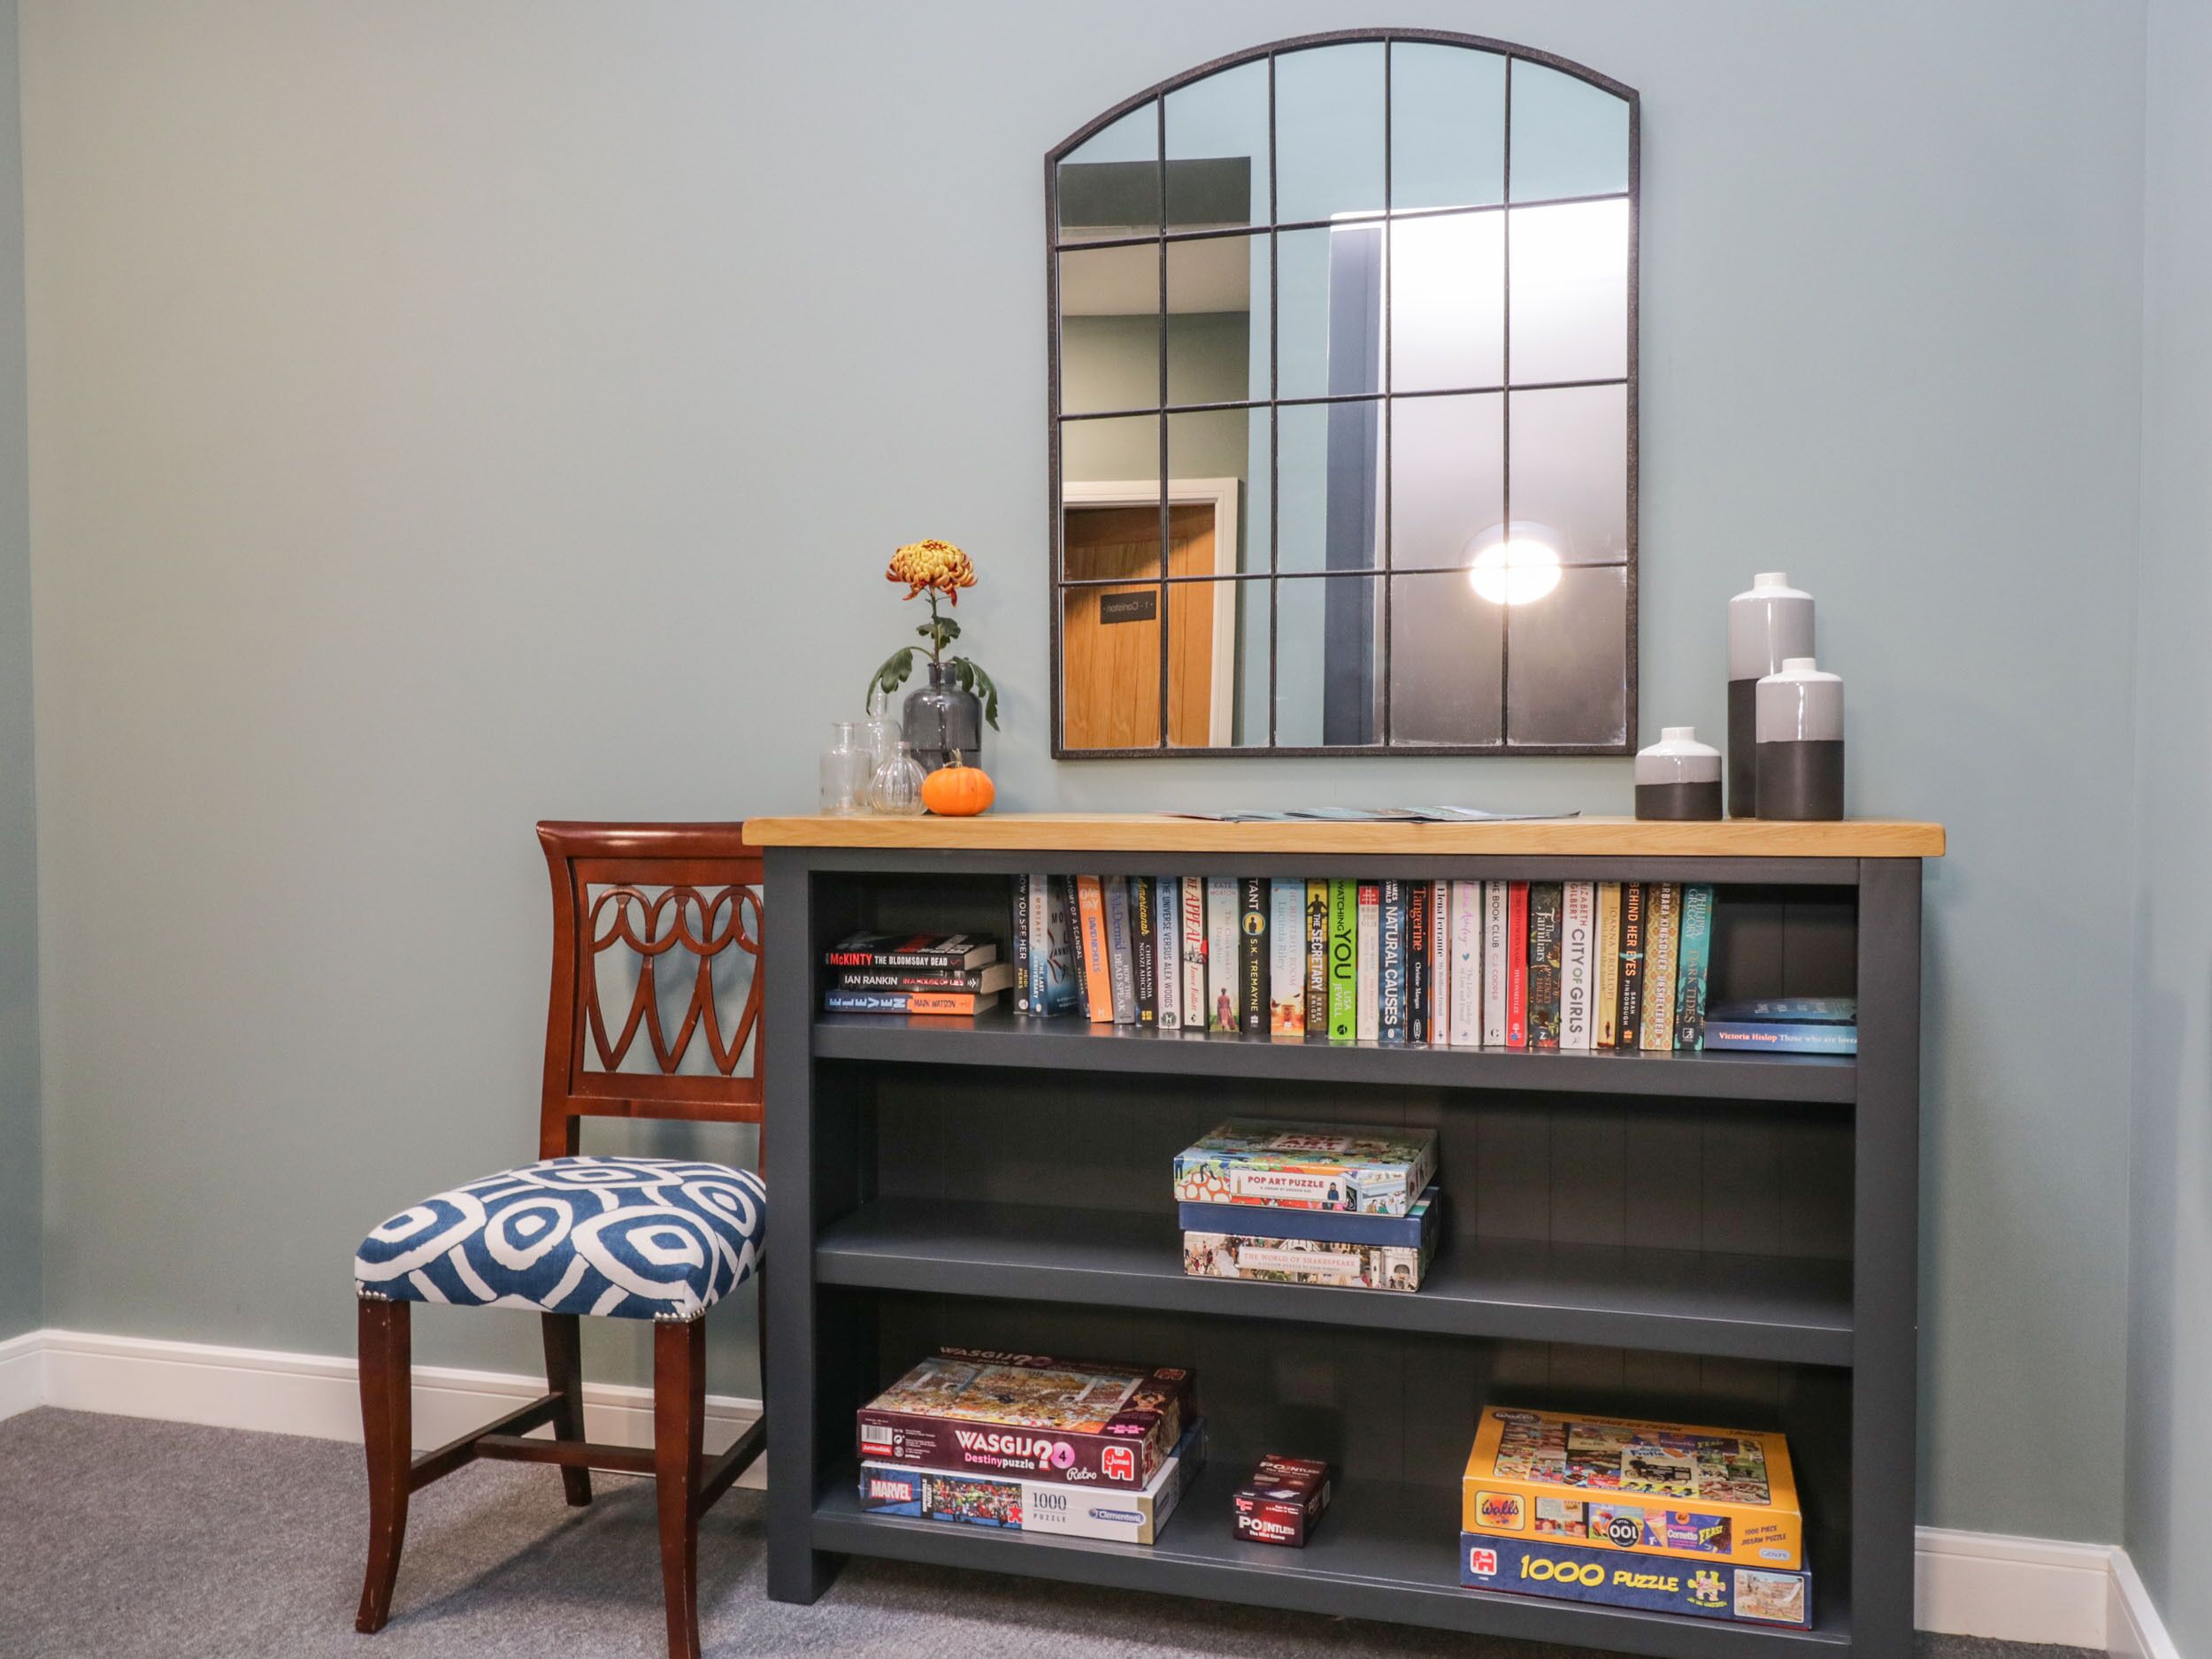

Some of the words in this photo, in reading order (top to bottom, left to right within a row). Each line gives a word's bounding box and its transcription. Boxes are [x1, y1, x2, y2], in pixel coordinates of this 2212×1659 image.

[1187, 877, 1197, 889] HE
[1248, 878, 1259, 910] TANT
[1018, 895, 1027, 916] YOU
[1071, 907, 1077, 916] OF
[1138, 879, 1148, 936] Americanah
[1628, 881, 1640, 921] BEHIND
[1661, 882, 1671, 916] ARBARA
[1163, 896, 1171, 930] UNIVERSE
[1186, 891, 1201, 943] APPEAL
[1410, 887, 1426, 950] Tangerine
[1686, 888, 1697, 938] GREGORY
[1018, 919, 1027, 937] SEE
[1386, 906, 1398, 967] NATURAL
[1536, 907, 1555, 962] Familiars
[1545, 924, 1554, 939] The
[1609, 906, 1618, 949] JOANNA
[1626, 926, 1638, 947] HER
[1018, 939, 1027, 960] HER
[1073, 926, 1083, 960] SCANDAL
[1163, 932, 1172, 960] VERSUS
[1334, 929, 1352, 979] YOU
[1571, 928, 1585, 965] CITY
[1657, 918, 1670, 971] KINGSOLVER
[830, 953, 872, 966] McKINTY
[874, 955, 887, 965] THE
[888, 955, 929, 966] BLOOMSDAY
[930, 956, 948, 966] DEAD
[1114, 954, 1123, 979] DEAD
[1164, 962, 1172, 981] ALEX
[1311, 929, 1323, 992] SECRETARY
[1625, 950, 1637, 977] EYES
[1686, 949, 1699, 984] DARK
[844, 975, 861, 984] IAN
[863, 975, 898, 986] RANKIN
[1572, 967, 1583, 984] OF
[1607, 951, 1617, 1001] TROLLOPE
[829, 997, 906, 1009] ELEVEN
[913, 999, 931, 1008] MARK
[1116, 981, 1126, 1011] SPEAK
[1164, 982, 1173, 1009] WOODS
[1333, 983, 1343, 1017] JEWELL
[1343, 990, 1352, 1011] LISA
[1385, 971, 1398, 1025] CAUSES
[1655, 976, 1665, 1034] UNSHELTERED
[1685, 987, 1697, 1023] TIDES
[1570, 987, 1583, 1033] GIRLS
[1719, 1032, 1750, 1041] Victoria
[1752, 1033, 1778, 1043] Hislop
[1779, 1033, 1802, 1042] Those
[1804, 1033, 1821, 1043] who
[1248, 1176, 1266, 1185] POP
[1288, 1179, 1325, 1188] PUZZLE
[1303, 1256, 1356, 1267] SHAKESPEARE
[964, 1452, 1035, 1470] Destinypuzzle
[1059, 1451, 1066, 1462] 4
[1066, 1467, 1097, 1481] Retro
[871, 1480, 911, 1501] MARVEL
[1033, 1493, 1068, 1510] 1000
[1033, 1512, 1066, 1523] PUZZLE
[1239, 1515, 1295, 1536] POINTLESS
[1667, 1528, 1698, 1541] Cornetto
[1698, 1525, 1724, 1546] FEAST
[1741, 1537, 1764, 1547] JIGSAW
[1764, 1533, 1787, 1543] PUZZLE
[1520, 1554, 1605, 1587] 1000
[1612, 1570, 1679, 1593] PUZZLE
